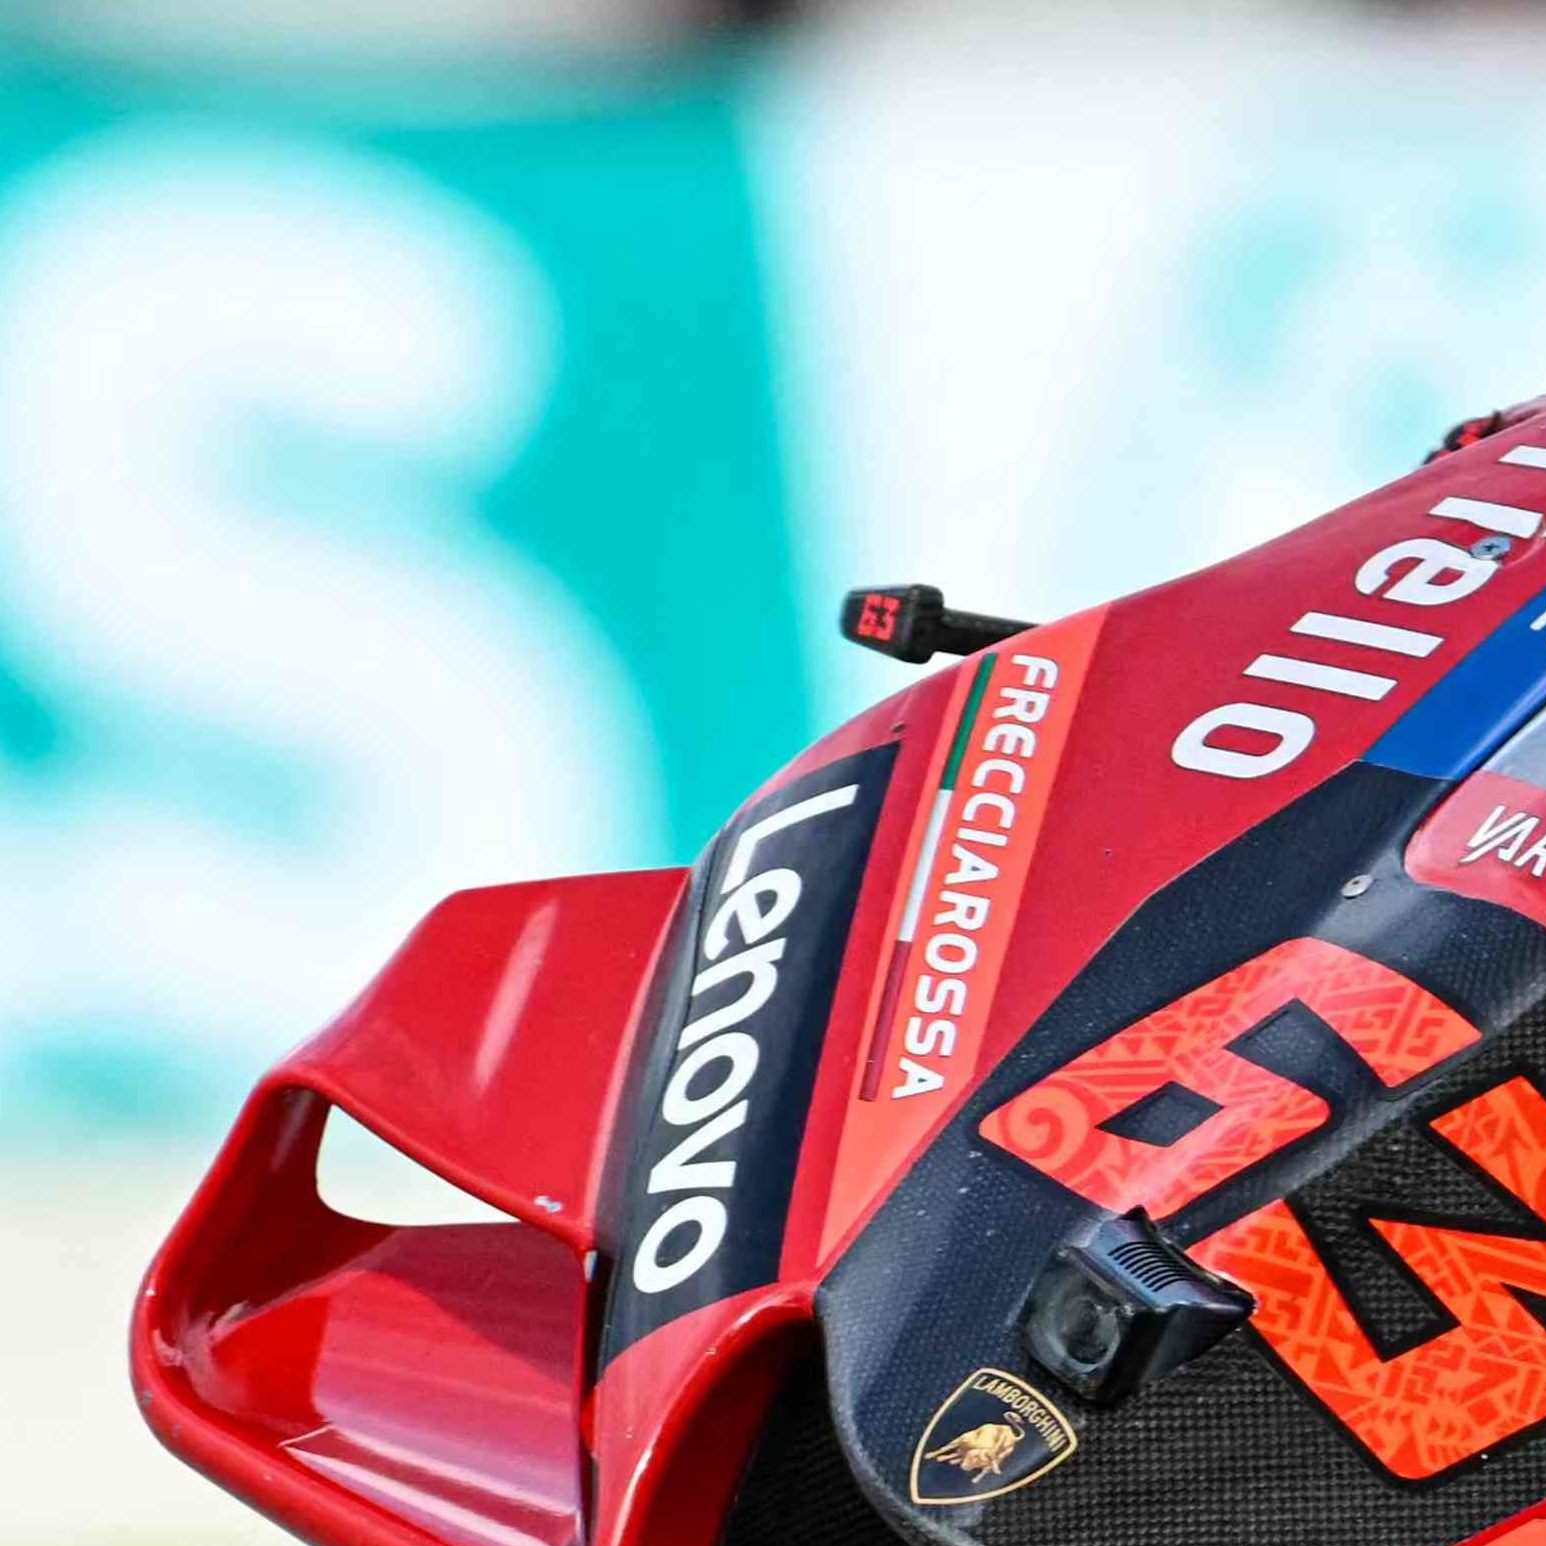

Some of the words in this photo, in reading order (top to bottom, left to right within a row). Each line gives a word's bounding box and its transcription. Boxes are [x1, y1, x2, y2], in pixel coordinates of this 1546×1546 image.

[631, 782, 860, 1296] Lenovo
[892, 653, 1060, 1101] FRECCIAROSSA
[973, 1371, 1069, 1457] LAMBORGHINI
